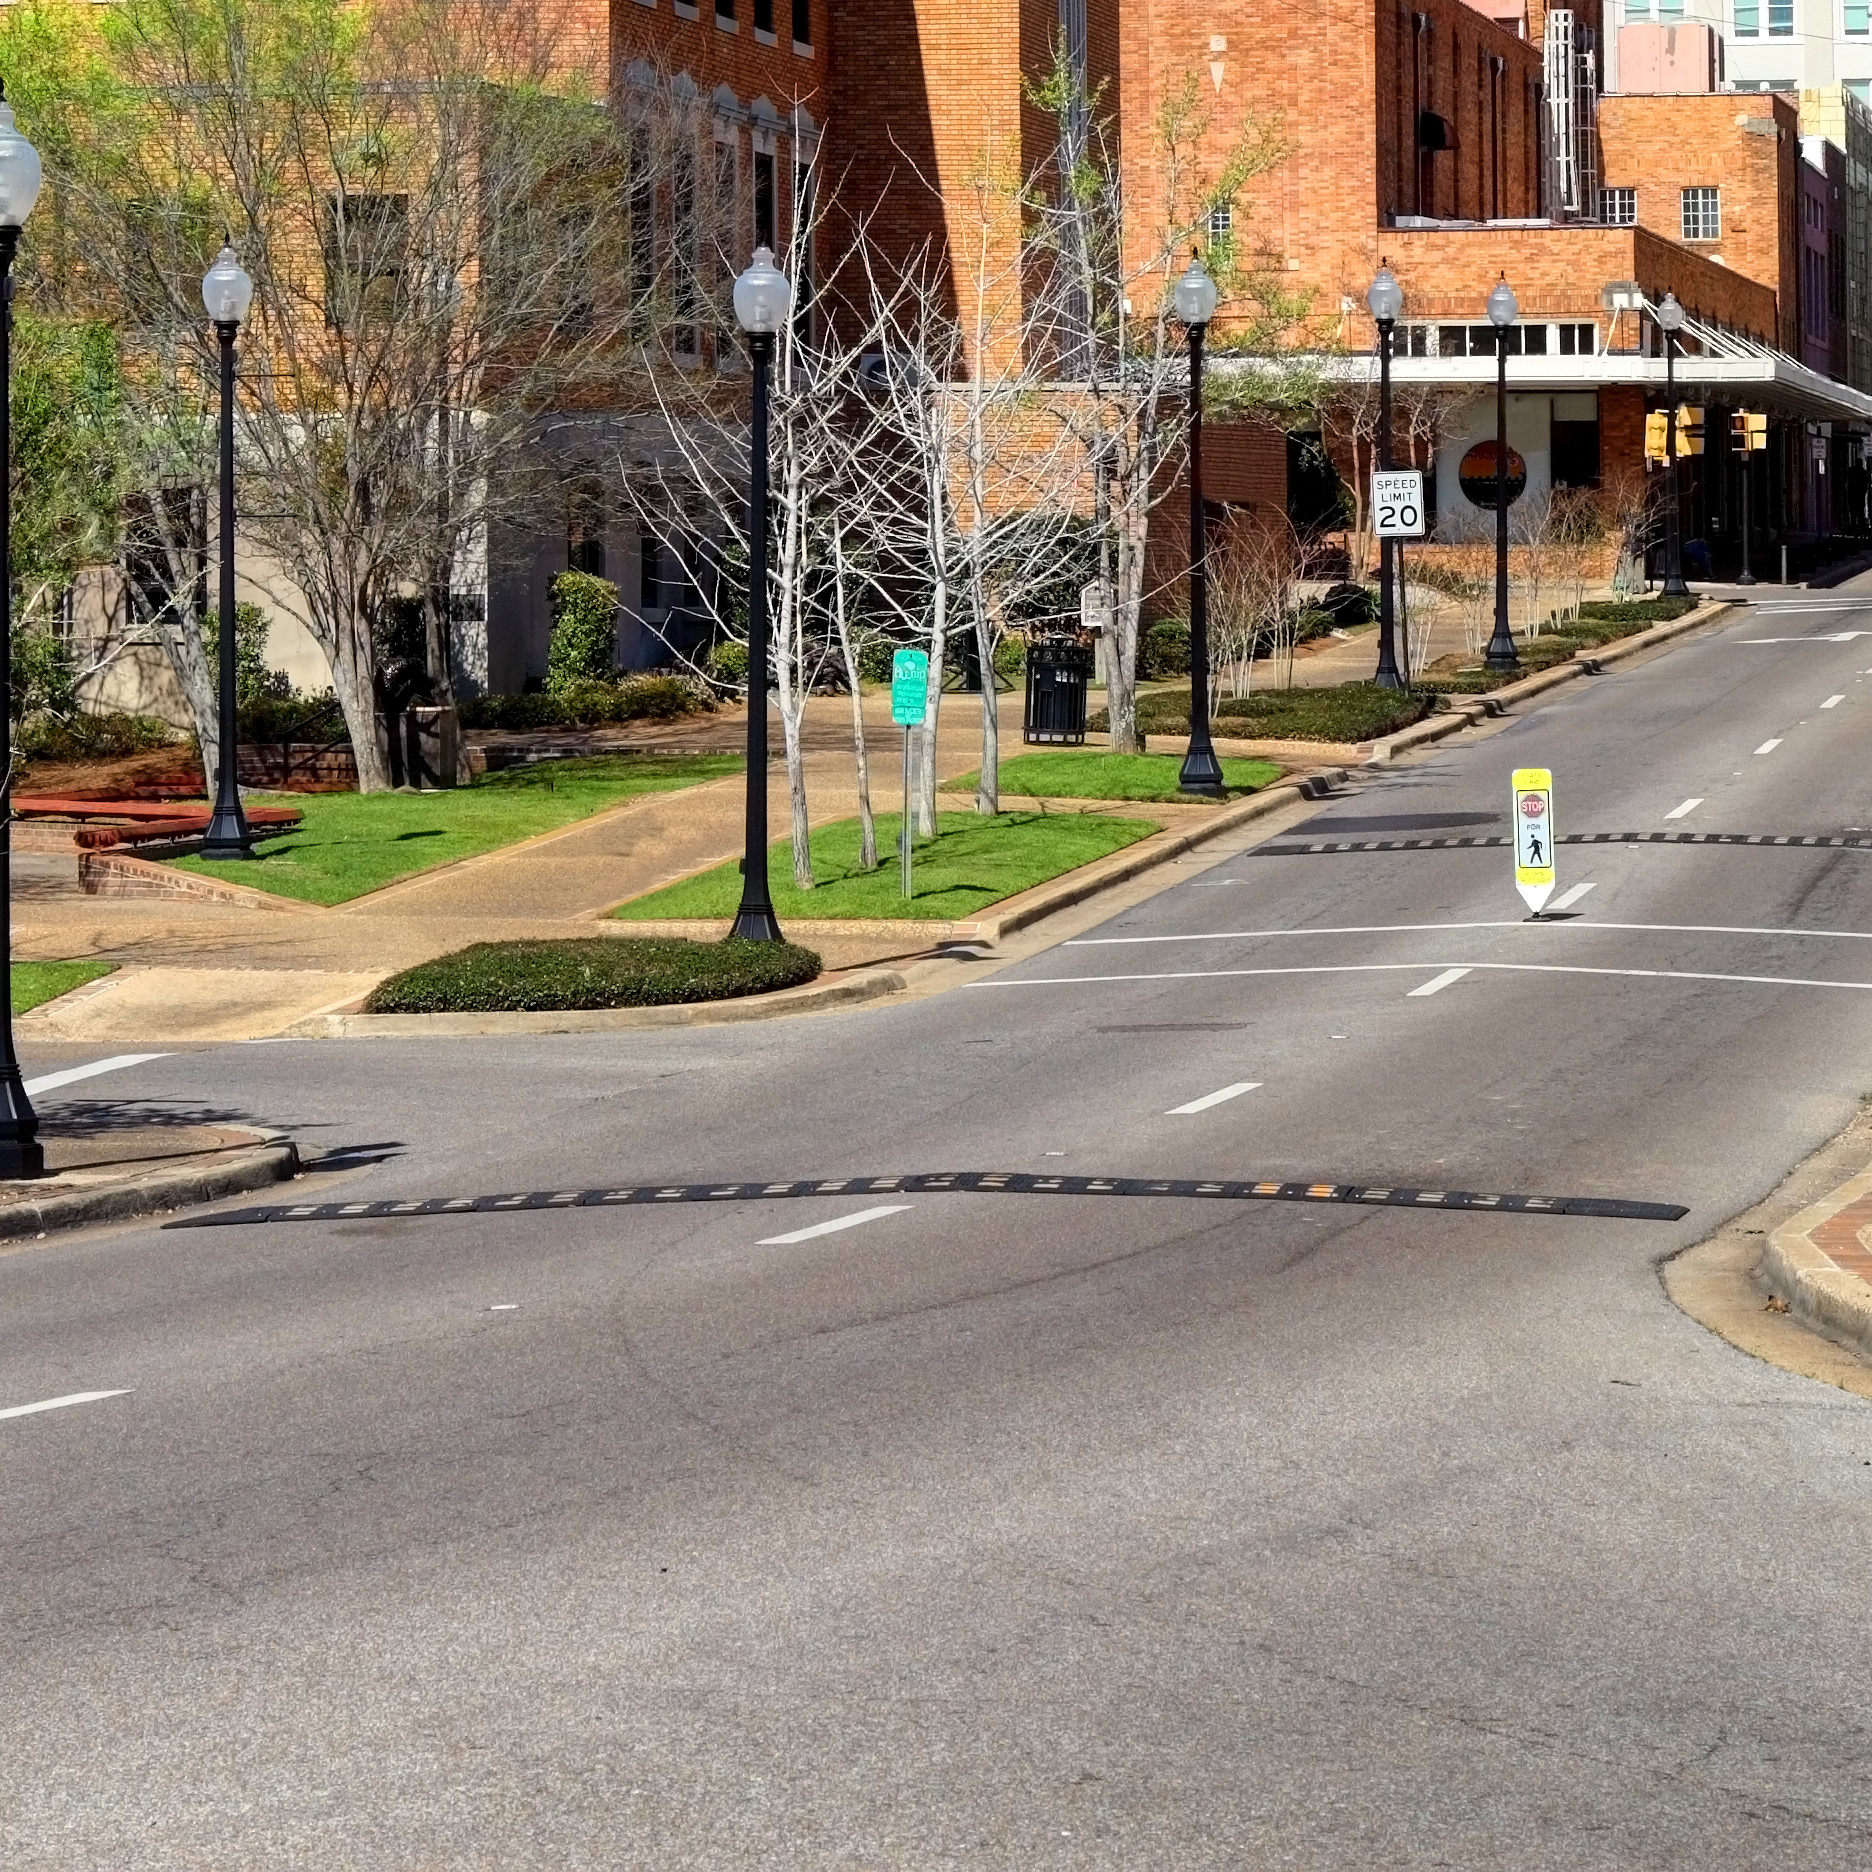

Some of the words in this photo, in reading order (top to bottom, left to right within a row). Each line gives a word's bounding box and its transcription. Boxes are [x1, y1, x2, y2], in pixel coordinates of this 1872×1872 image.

[1377, 479, 1417, 489] SPEED
[1381, 492, 1413, 502] LIMIT
[1379, 505, 1417, 527] 20
[1522, 801, 1544, 812] STOP
